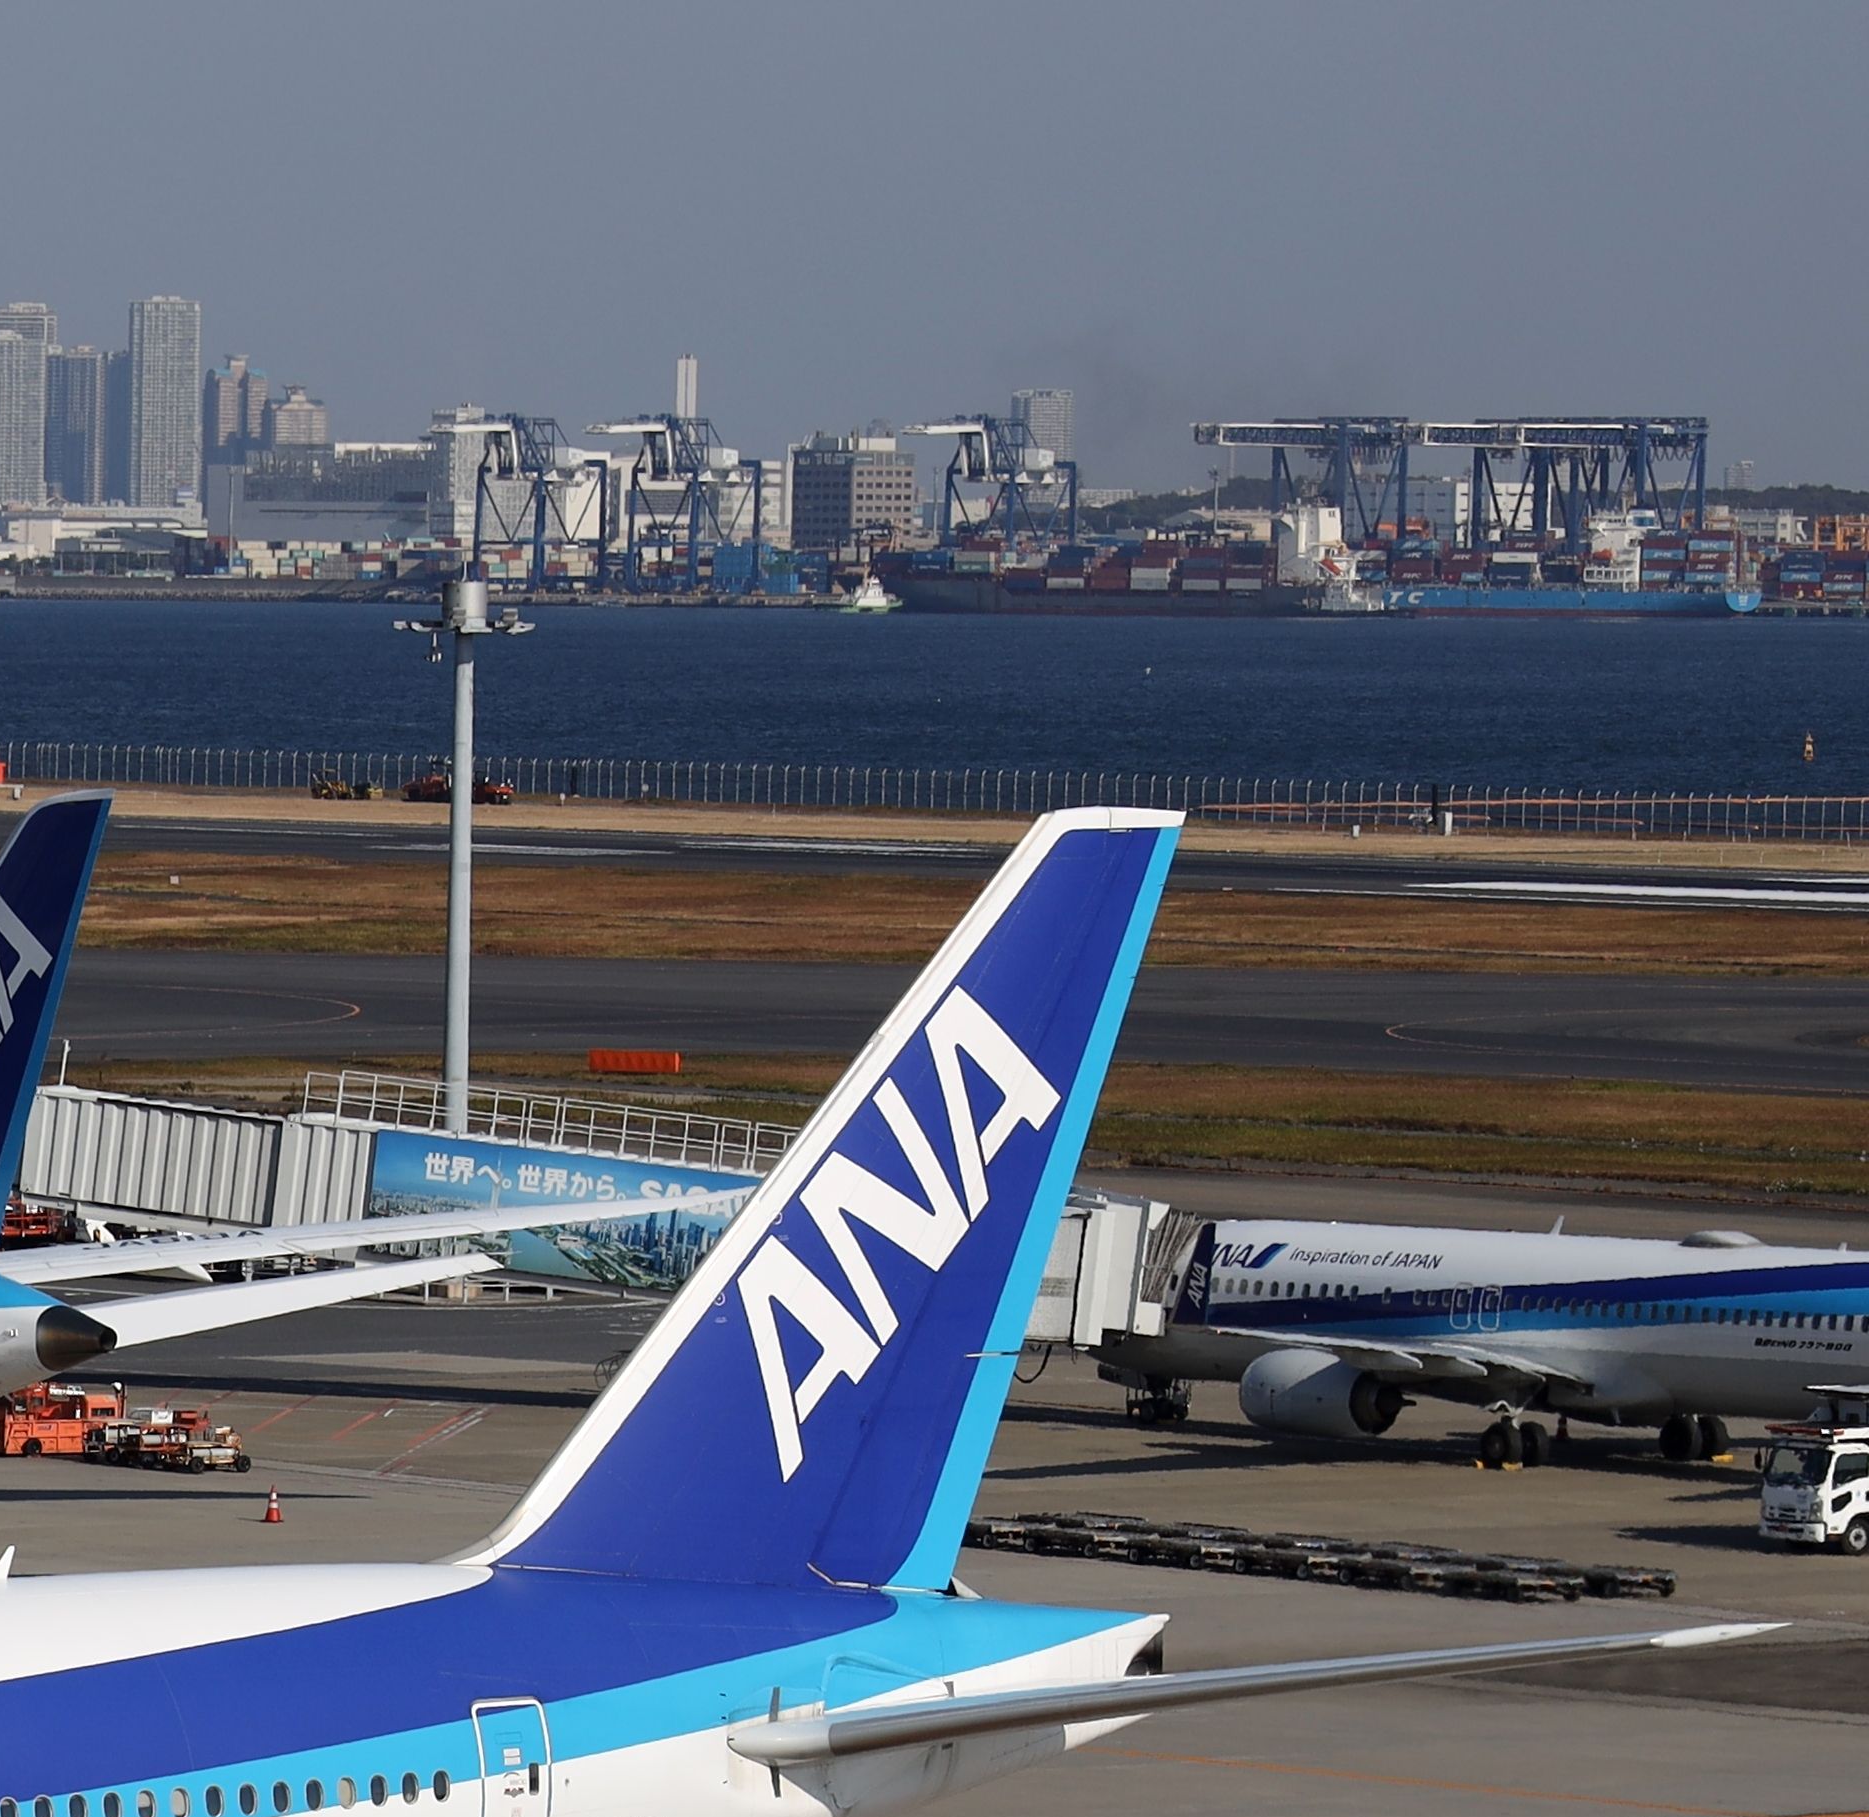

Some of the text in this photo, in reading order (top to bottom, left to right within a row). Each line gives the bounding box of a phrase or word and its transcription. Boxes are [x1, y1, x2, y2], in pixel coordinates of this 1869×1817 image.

[424, 1152, 627, 1201] 世界へ。 世界から。
[737, 985, 1061, 1483] ANA
[1212, 1243, 1254, 1268] NA
[1289, 1247, 1443, 1270] Inspiration of JAPAN
[1188, 1262, 1207, 1309] ANA
